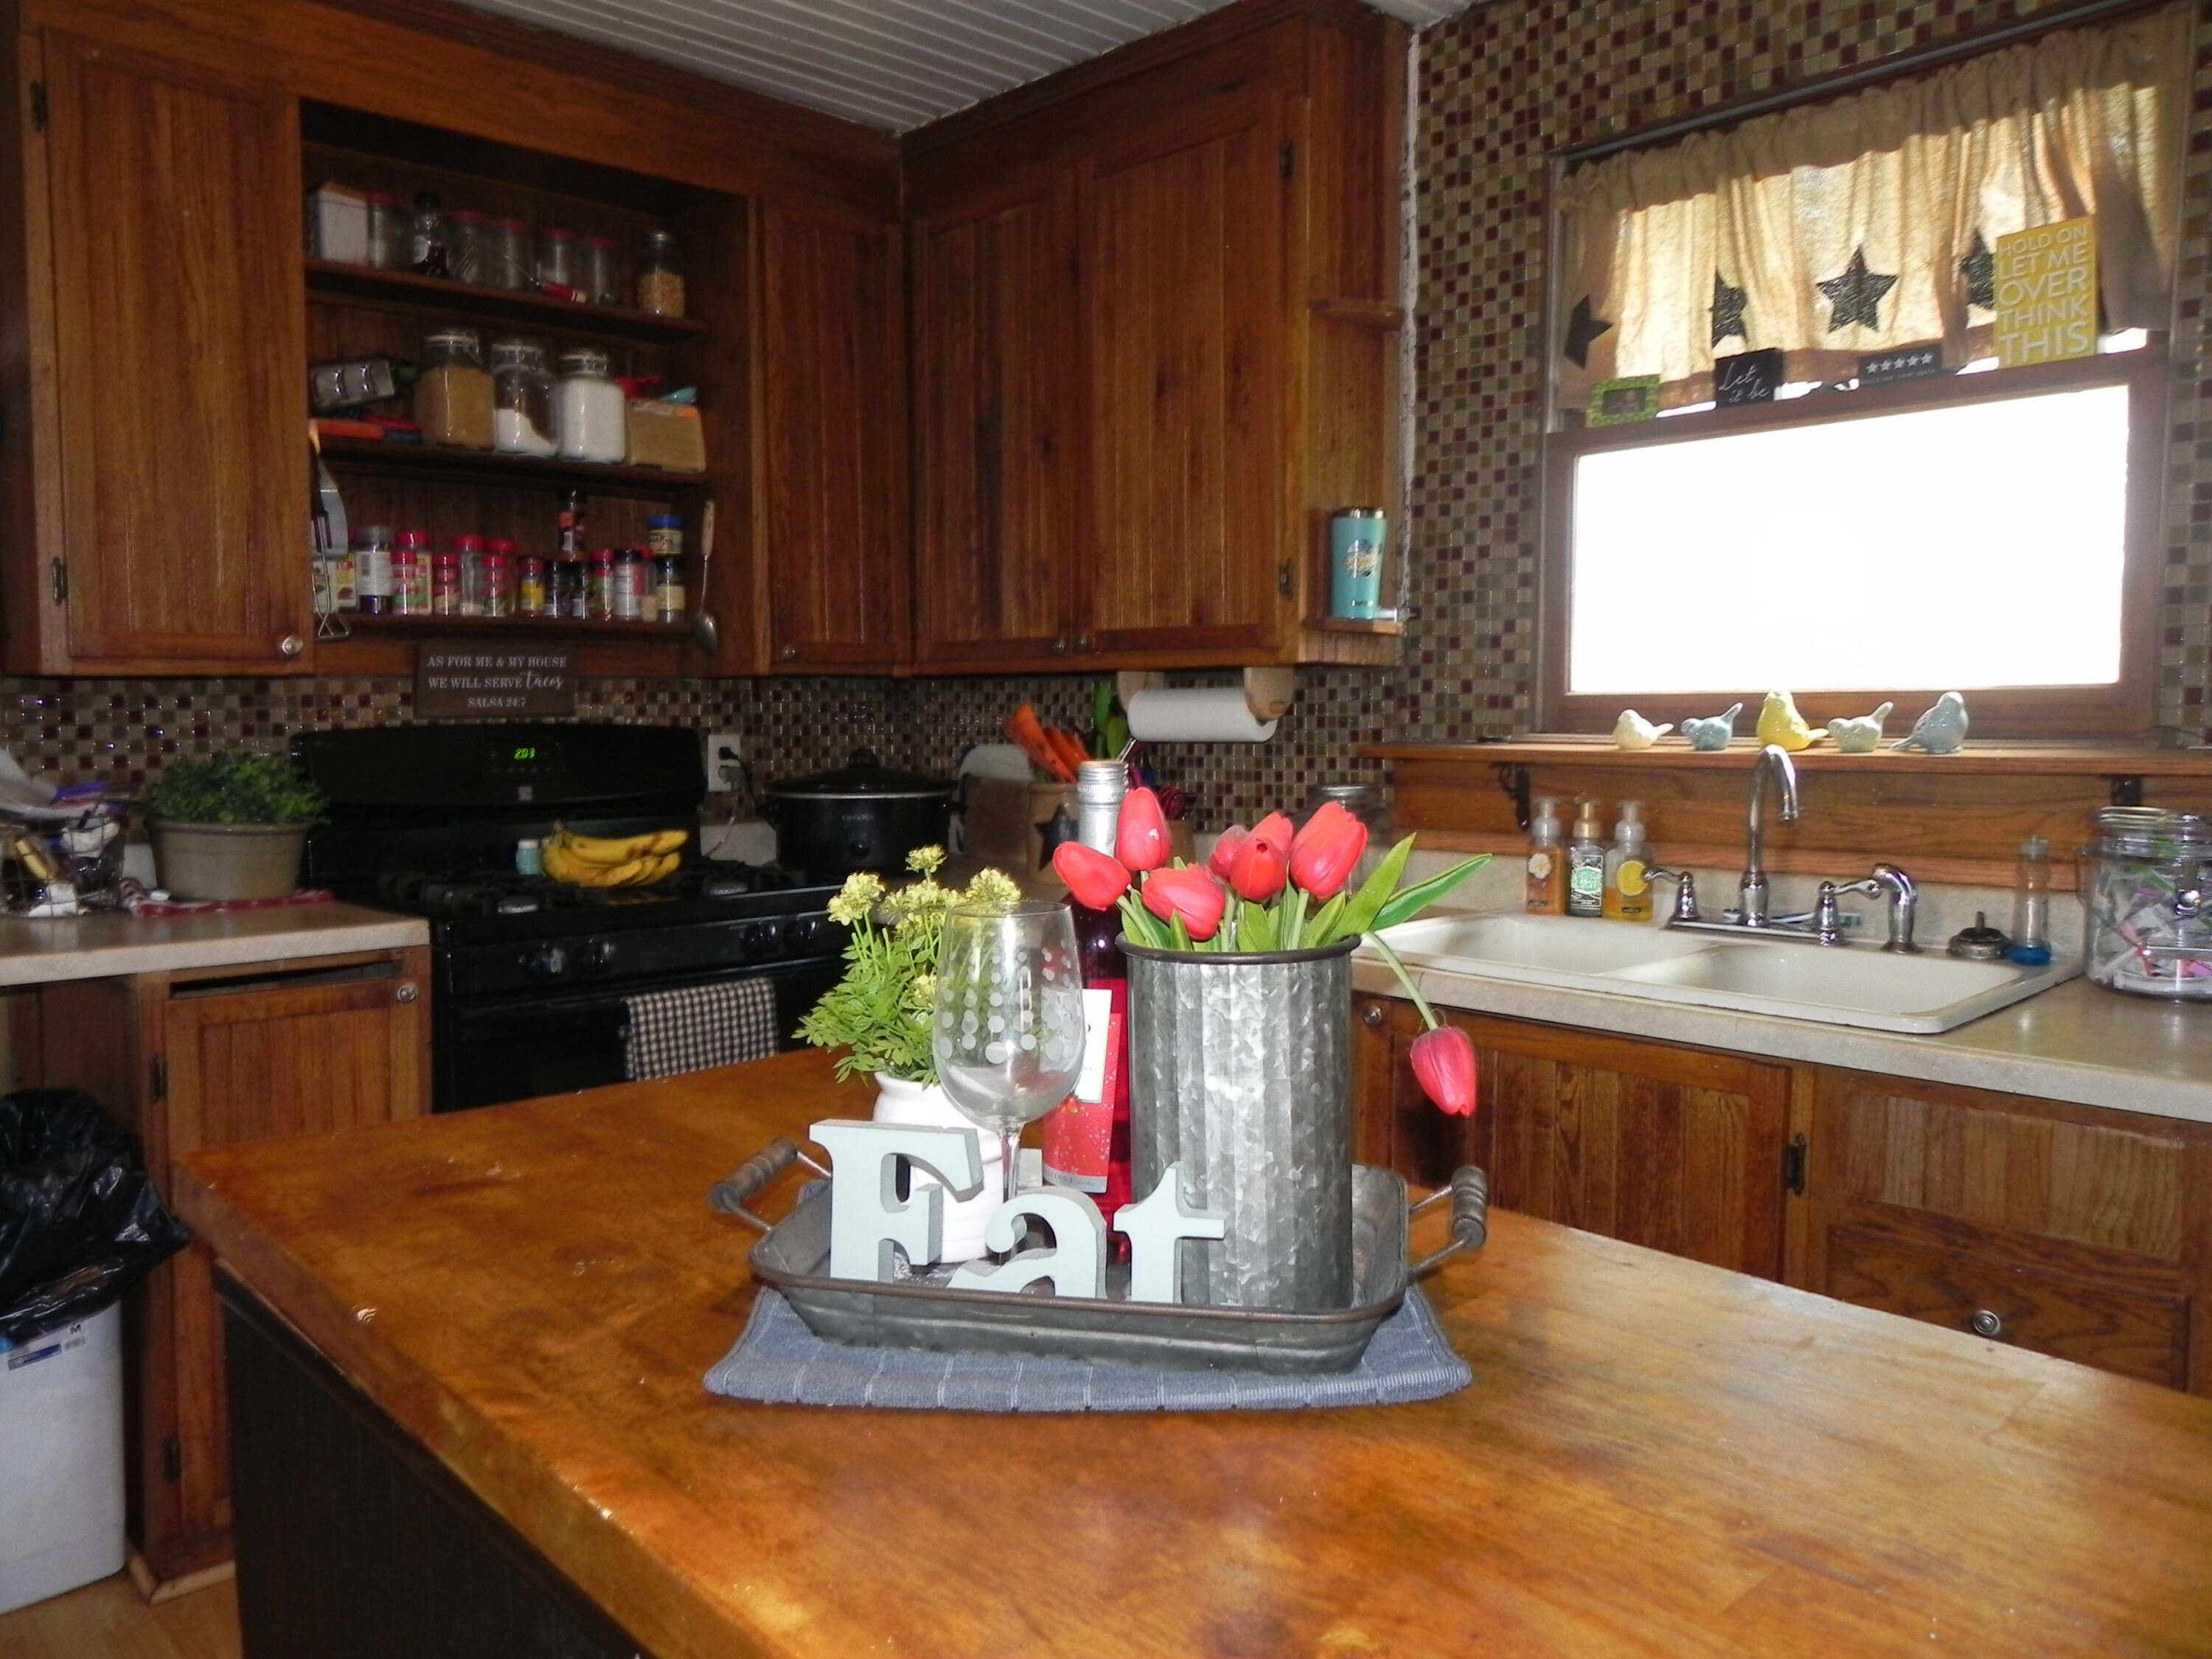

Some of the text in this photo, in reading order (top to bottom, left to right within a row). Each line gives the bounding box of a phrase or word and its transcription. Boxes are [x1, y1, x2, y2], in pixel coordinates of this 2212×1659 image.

[1999, 227, 2087, 257] HOLD ON
[1999, 242, 2088, 280] LET ME
[1999, 267, 2087, 307] OVER
[1998, 294, 2090, 331] THINK
[1998, 321, 2089, 365] THIS
[1718, 361, 1758, 391] Let
[1728, 377, 1770, 403] it be
[427, 655, 567, 667] AS FOR ME & MY HOUSE
[428, 670, 565, 689] WE WILL SERVE tacos
[467, 697, 503, 708] SALSA
[809, 1119, 1231, 1303] Eat
